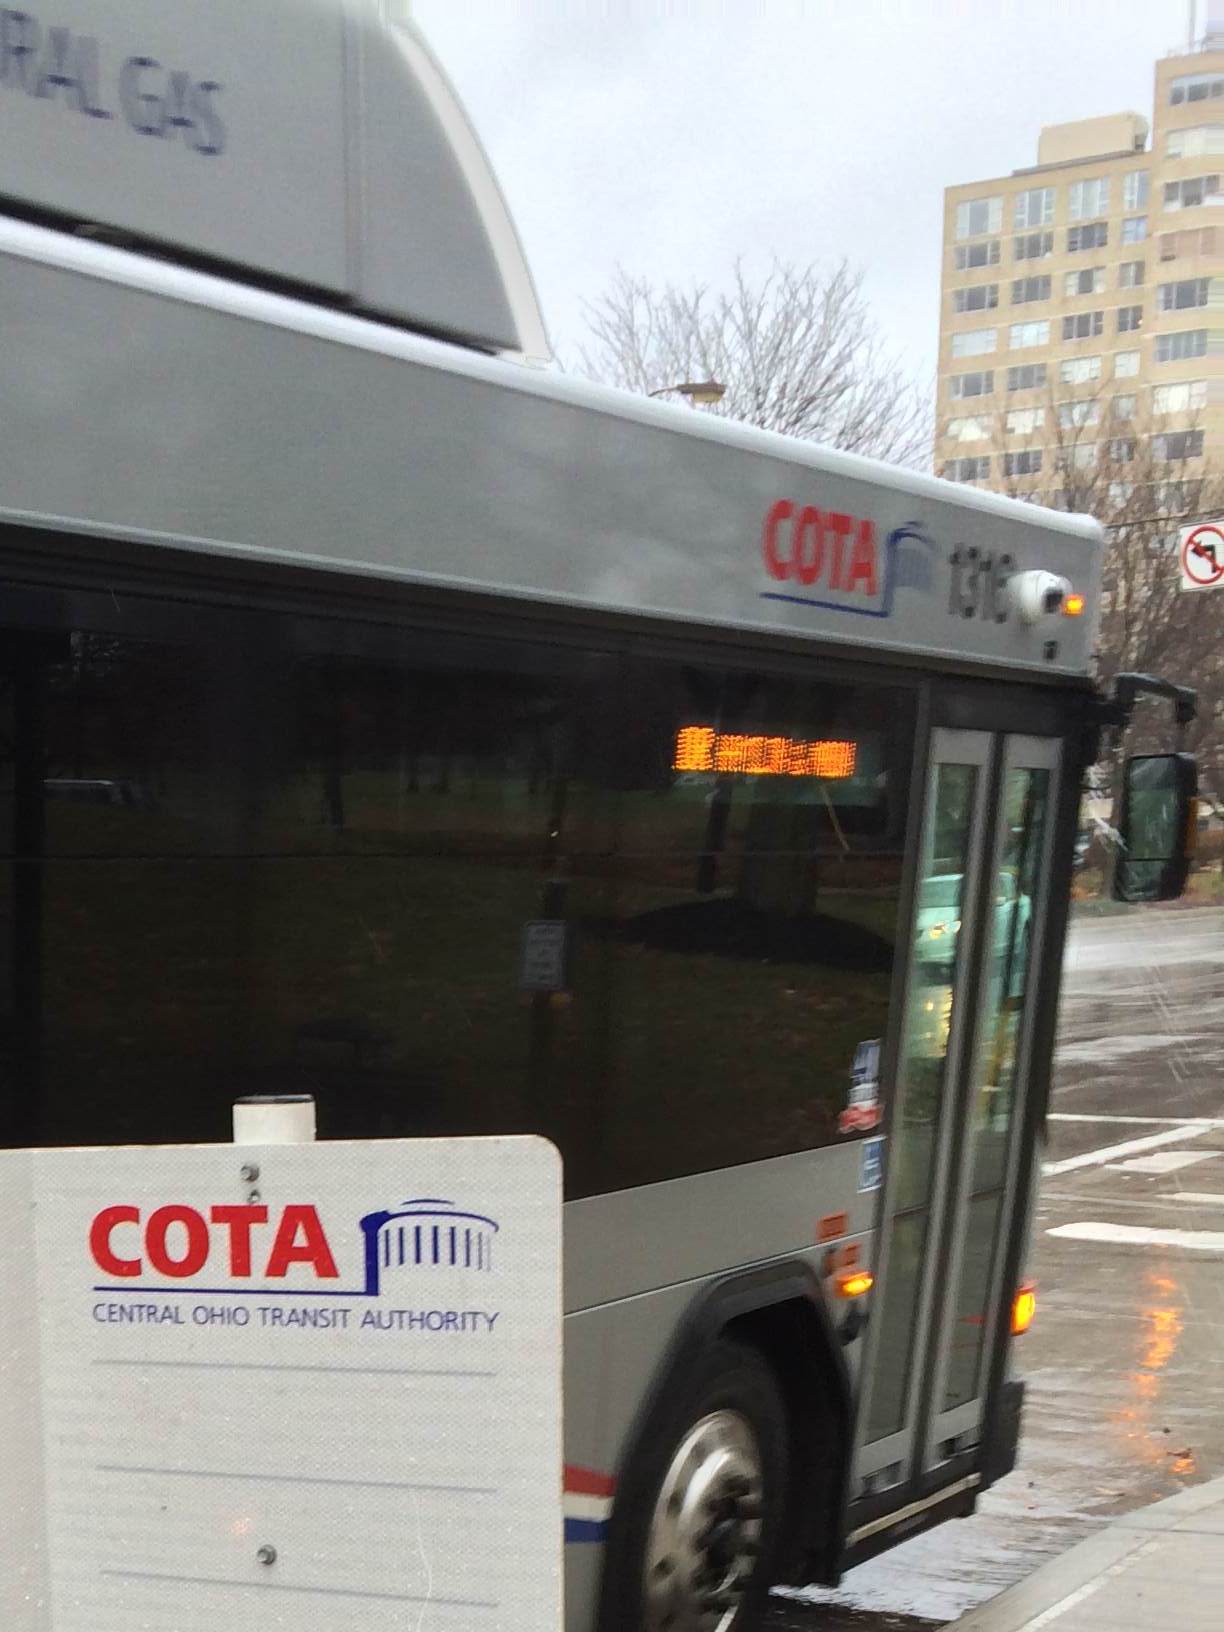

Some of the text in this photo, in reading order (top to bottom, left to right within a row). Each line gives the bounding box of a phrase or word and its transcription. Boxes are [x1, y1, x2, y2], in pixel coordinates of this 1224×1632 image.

[120, 56, 226, 155] GAS
[763, 499, 877, 596] COTA
[89, 1204, 339, 1278] COTA
[92, 1303, 501, 1333] CENTRAL OHIO TRANSIT AUTHORITY
